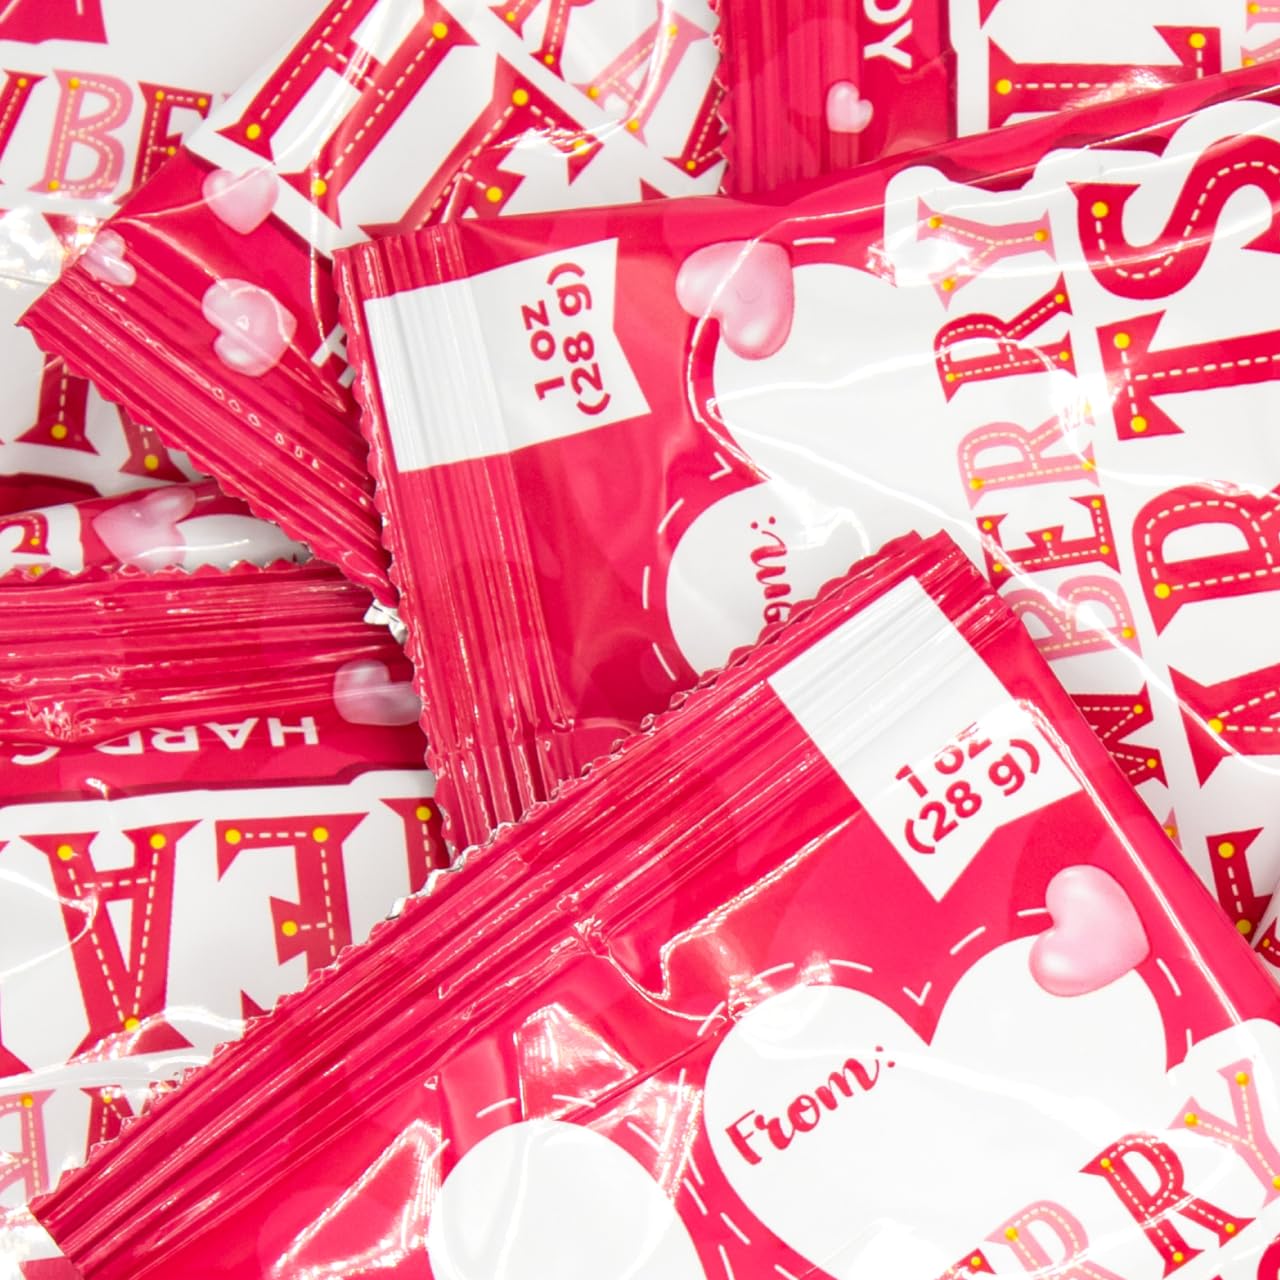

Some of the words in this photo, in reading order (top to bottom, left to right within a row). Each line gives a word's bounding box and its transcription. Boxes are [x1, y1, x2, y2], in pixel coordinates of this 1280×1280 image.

[547, 261, 592, 319] g)
[521, 301, 556, 361] oz
[535, 375, 566, 400] 1
[563, 331, 609, 416] (28
[895, 766, 928, 798] 1
[934, 722, 996, 776] oz
[903, 781, 983, 857] (28
[989, 738, 1041, 796] g)
[724, 1045, 897, 1168] From:
